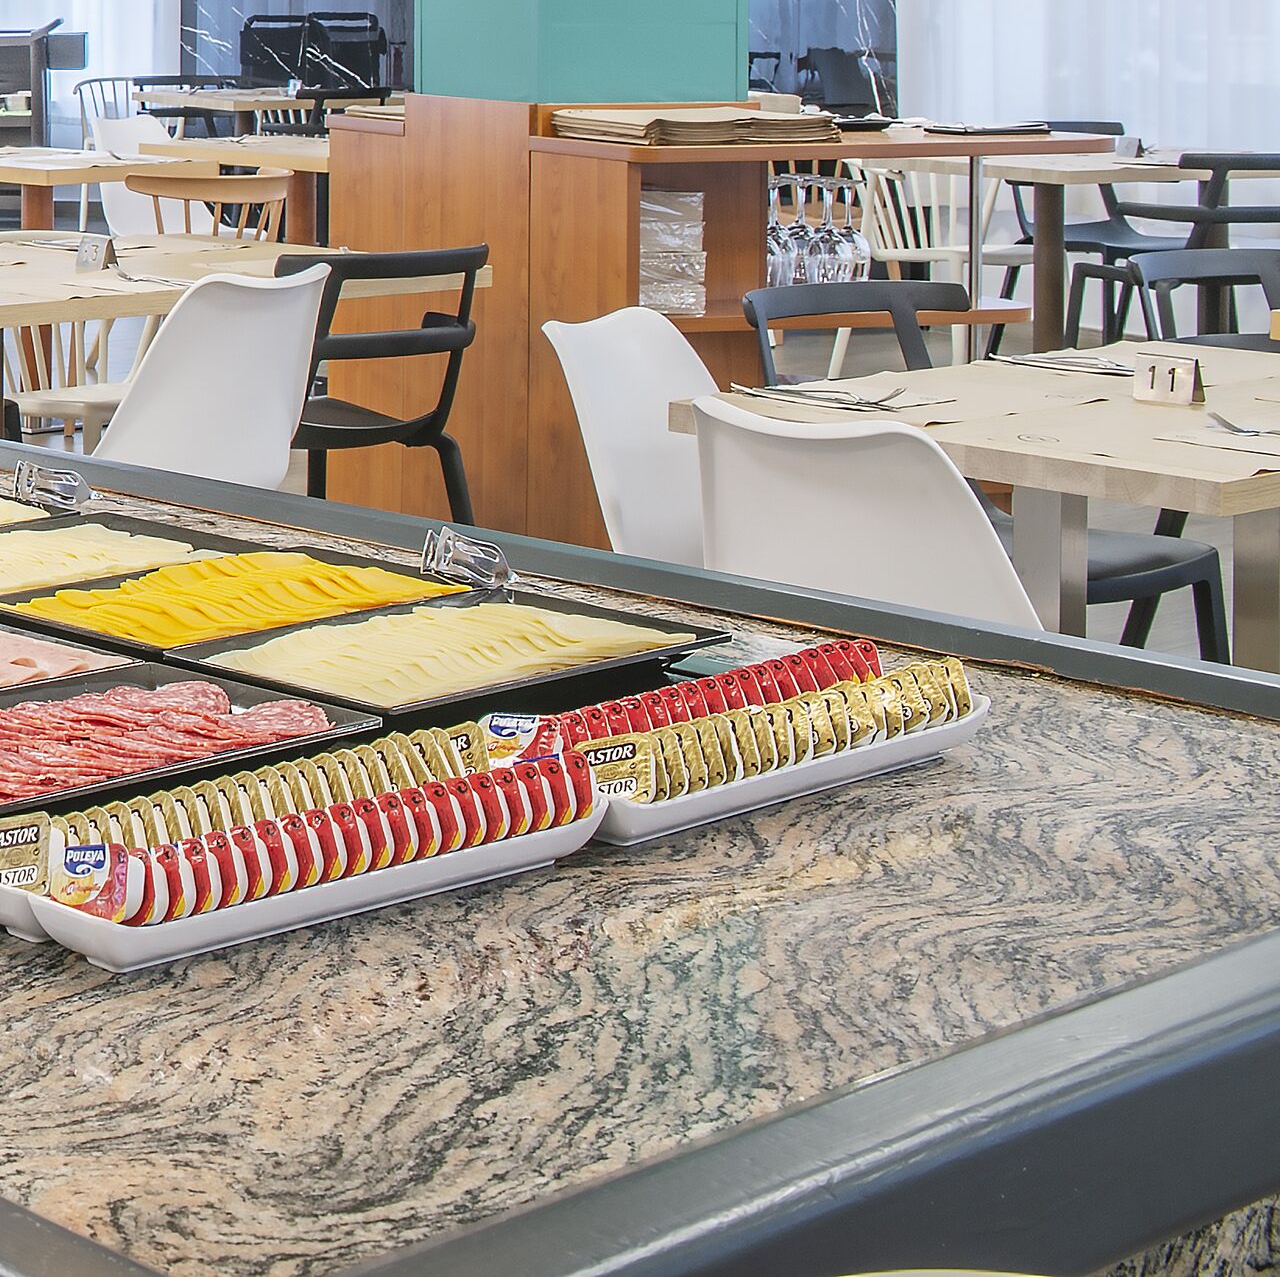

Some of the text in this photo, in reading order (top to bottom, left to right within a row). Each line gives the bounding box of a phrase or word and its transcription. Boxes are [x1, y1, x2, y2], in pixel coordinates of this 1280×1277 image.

[1148, 365, 1176, 392] 11
[587, 744, 634, 765] ASTOR
[597, 779, 633, 795] STOR
[65, 849, 105, 863] PULEVA
